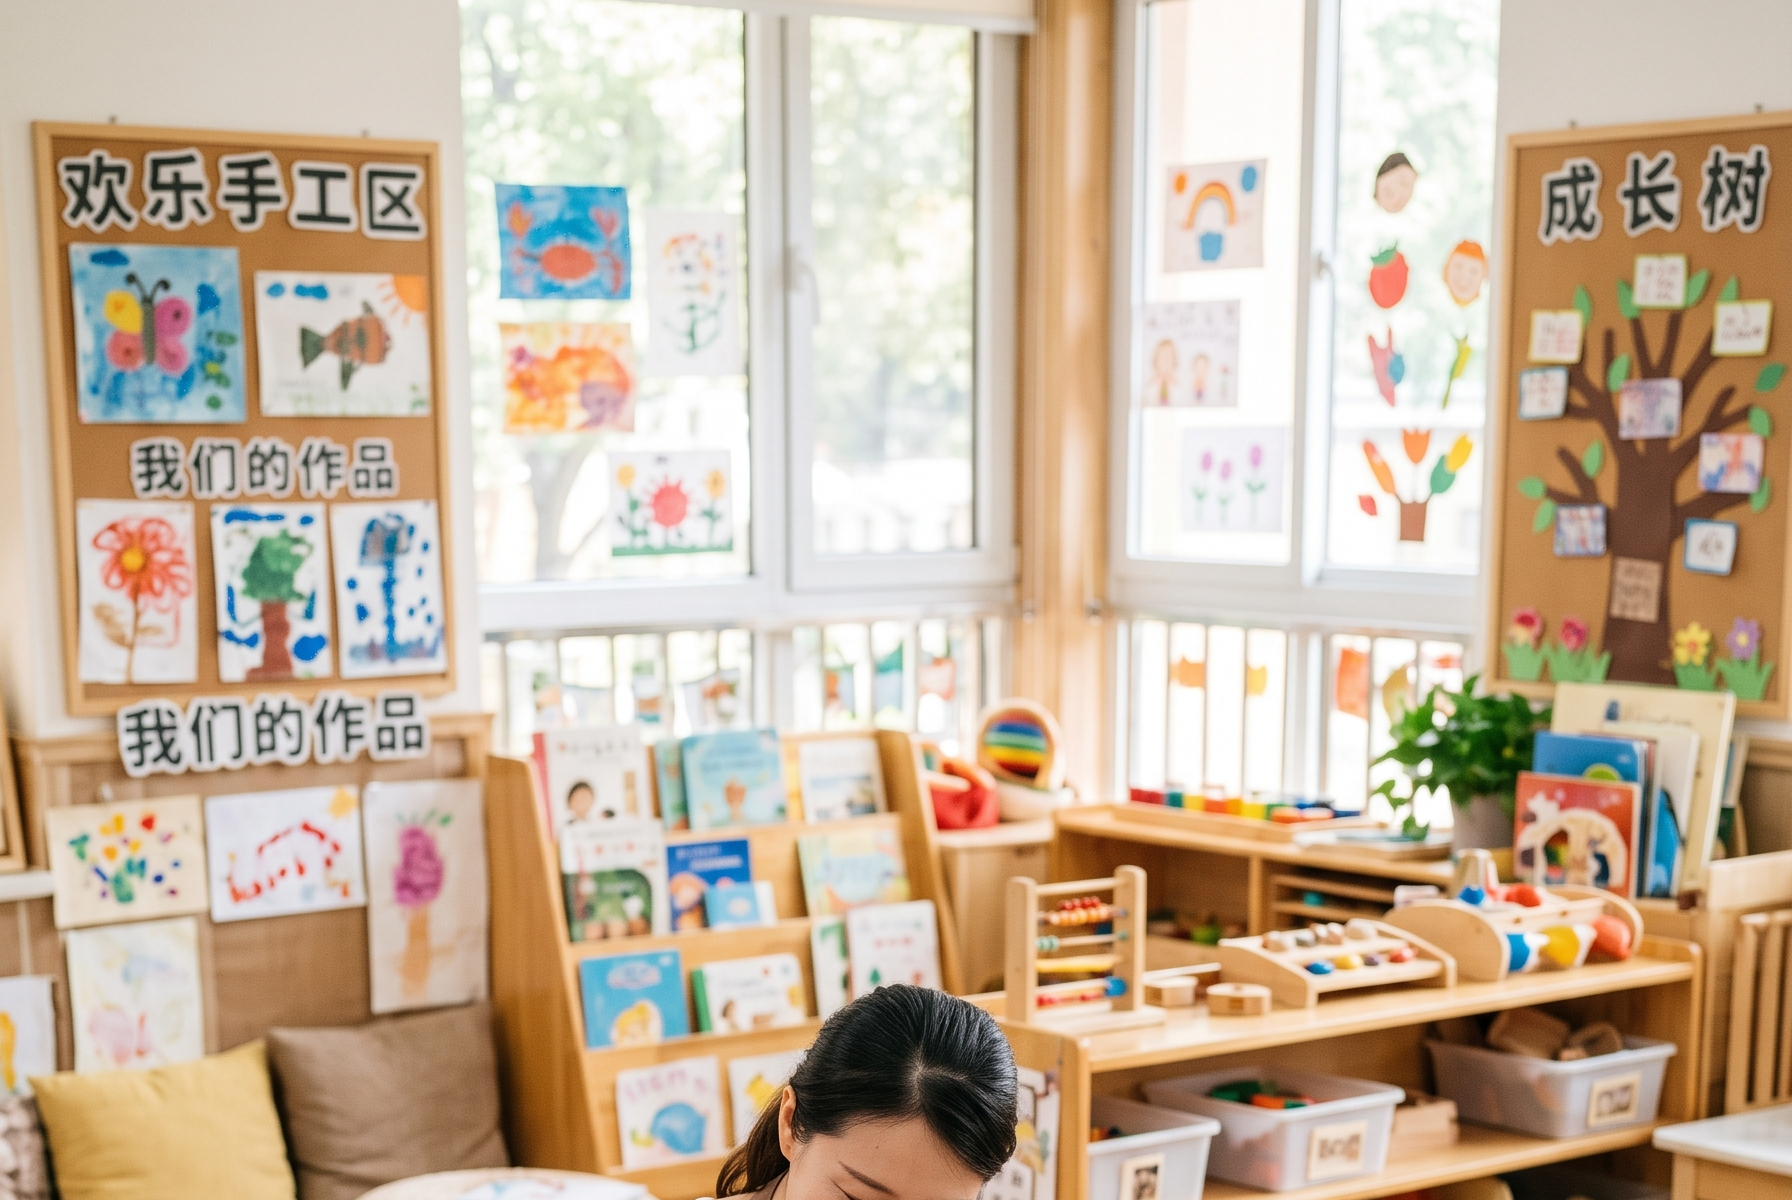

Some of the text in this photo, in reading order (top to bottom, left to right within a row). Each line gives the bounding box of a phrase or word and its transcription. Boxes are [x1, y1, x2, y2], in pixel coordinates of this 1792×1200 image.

[64, 155, 420, 232] 欢乐手工区
[1546, 150, 1764, 236] 成长树
[136, 443, 393, 491] 我们的作品
[126, 697, 423, 766] 我们的作品
